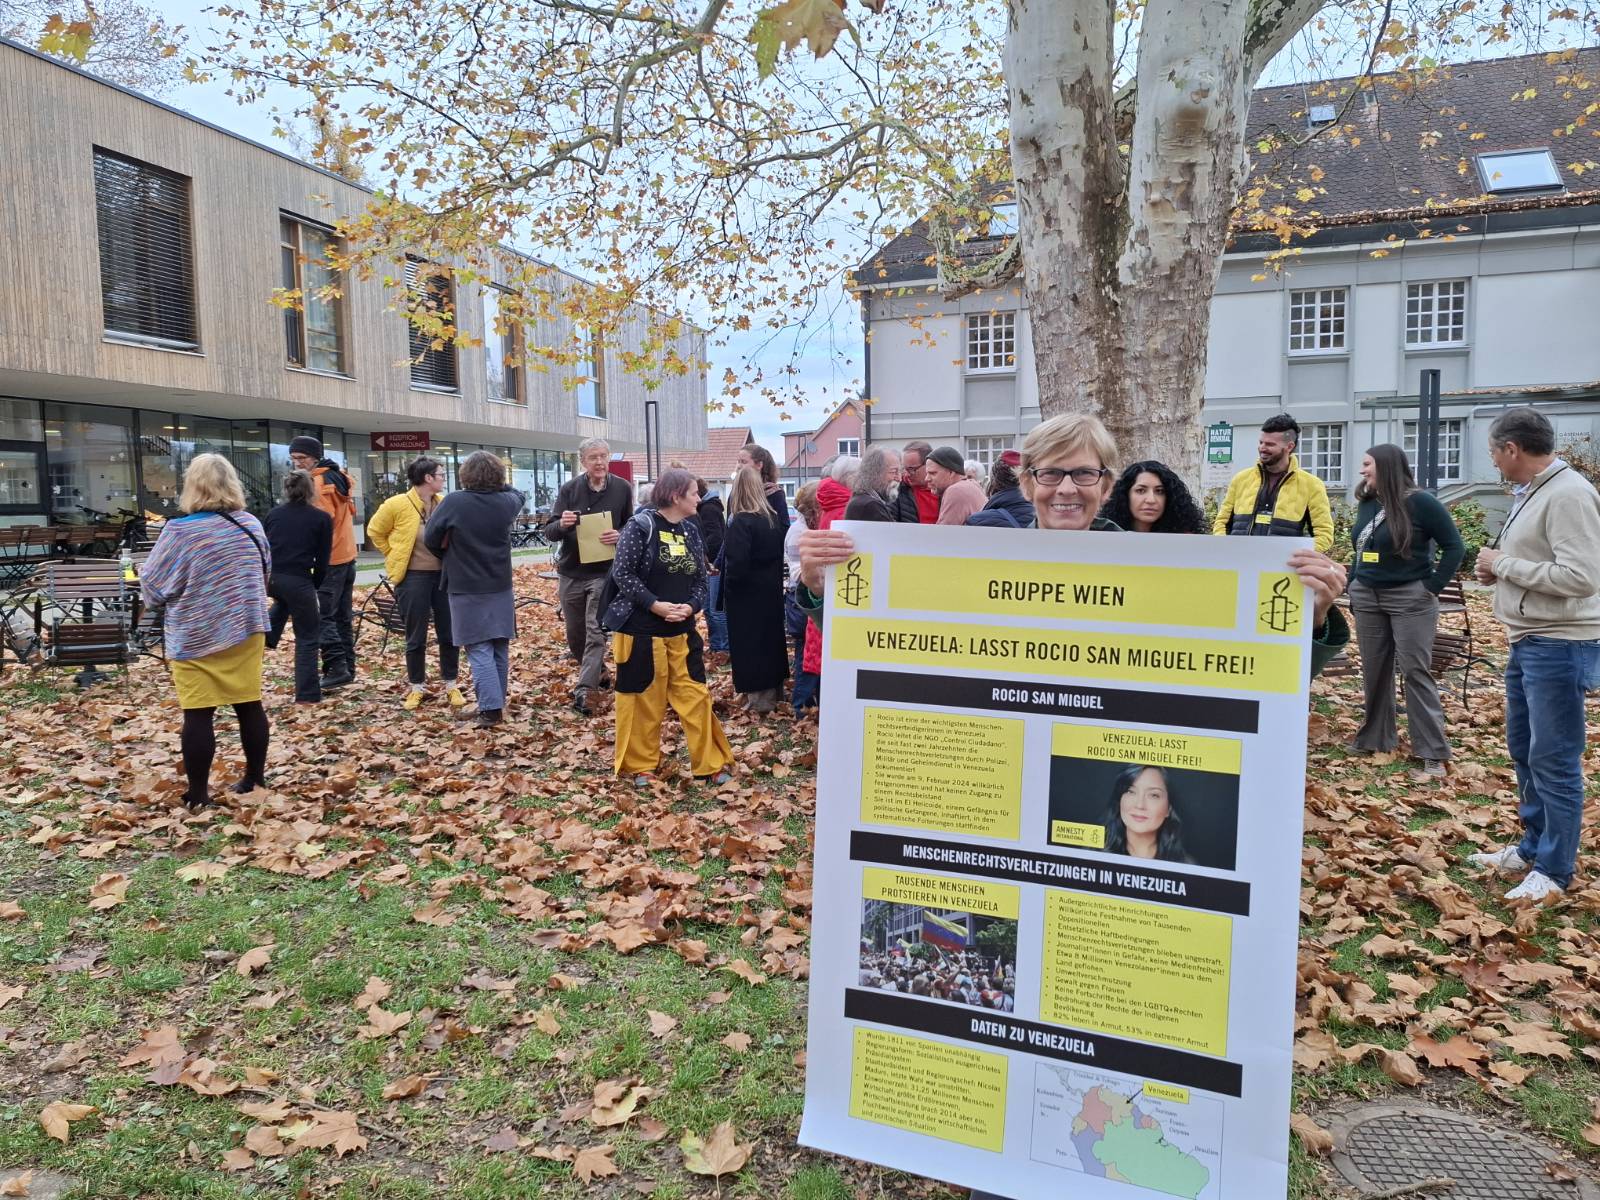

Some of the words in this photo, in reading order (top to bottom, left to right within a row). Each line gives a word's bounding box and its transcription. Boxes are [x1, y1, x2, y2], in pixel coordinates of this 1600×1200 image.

[988, 580, 1065, 603] GRUPPE
[1074, 584, 1124, 606] WIEN
[866, 631, 963, 654] VENEZUELA:
[970, 638, 1020, 658] LASST
[1026, 642, 1080, 662] ROCIO
[1087, 646, 1120, 664] SAN
[1128, 649, 1196, 671] MIGUEL
[1204, 654, 1254, 675] FREI!
[992, 688, 1028, 703] ROCIO
[1032, 690, 1054, 704] SAN
[1058, 692, 1104, 710] MIGUEL
[932, 719, 967, 727] wichtigsten
[969, 722, 1003, 730] Menschen-
[953, 729, 985, 737] Venezuela
[928, 743, 966, 752] Jahrzehnten
[1102, 732, 1156, 747] VENEZUELA:
[1160, 740, 1188, 750] LASST
[876, 747, 963, 761] Menschenrechtsverletzungen
[1088, 746, 1115, 757] ROCIO
[1118, 748, 1136, 760] SAN
[1138, 750, 1174, 764] MIGUEL
[1176, 754, 1202, 767] FREI!
[910, 758, 952, 768] Geheimdienst
[962, 764, 994, 772] Venezuela
[874, 780, 919, 790] festgenommen
[946, 787, 967, 795] keinen
[968, 790, 991, 798] Zugang
[972, 781, 1004, 790] willkürlich
[894, 790, 941, 800] Rechtsbeistand
[873, 804, 902, 813] politische
[873, 812, 915, 822] systematische
[966, 806, 997, 815] Gefängnis
[1056, 825, 1085, 835] AMNESTY
[902, 844, 1096, 882] MENSCHENRECHTSVERLETZUNGEN
[1100, 870, 1113, 884] IN
[1116, 872, 1186, 896] VENEZUELA
[896, 875, 936, 890] TAUSENDE
[940, 881, 985, 896] MENSCHEN
[882, 887, 936, 902] PROTSTIEREN
[940, 894, 948, 904] IN
[951, 896, 998, 912] VENEZUELA
[1059, 896, 1116, 911] Außergerichtliche
[1119, 906, 1168, 919] Hinrichtungen
[1058, 905, 1097, 917] Willkürliche
[1099, 912, 1136, 923] Festnahme
[1153, 920, 1190, 932] Tausenden
[1058, 914, 1109, 928] Oppositionellen
[1057, 923, 1098, 935] Entsetzliche
[1100, 930, 1159, 945] Haftbedingungen
[1057, 931, 1154, 954] Menschenrechtsverletzungen
[1156, 948, 1182, 958] blieben
[1056, 958, 1072, 966] Land
[1056, 949, 1072, 957] Etwa
[1081, 954, 1112, 965] Millionen
[1196, 974, 1211, 982] dem
[1122, 952, 1147, 962] Gefahr,
[1149, 956, 1168, 965] keine
[1170, 960, 1224, 975] Medienfreiheit!
[1055, 967, 1131, 987] Umweltverschmutzung
[1055, 976, 1077, 986] Gewalt
[1079, 982, 1099, 990] gegen
[1101, 984, 1124, 994] Frauen
[1054, 985, 1073, 994] Keine
[1076, 989, 1114, 1001] Fortschritte
[1116, 996, 1126, 1004] bei
[1129, 999, 1141, 1007] den
[1054, 994, 1089, 1007] Bedrohung
[1105, 1003, 1128, 1013] Rechte
[1131, 1008, 1142, 1016] der
[1054, 1003, 1094, 1017] Bevölkerung
[970, 1018, 1006, 1038] DATEN
[1009, 1026, 1024, 1042] ZU
[1028, 1030, 1095, 1056] VENEZUELA
[1053, 1011, 1069, 1020] 82%
[1071, 1015, 1089, 1024] leben
[1100, 1021, 1123, 1031] Armut,
[1126, 1026, 1143, 1035] 53%
[1154, 1031, 1184, 1043] extremer
[1186, 1038, 1208, 1048] Armut
[912, 1067, 924, 1075] und
[955, 1059, 1000, 1073] ausgerichtetes
[908, 1075, 922, 1083] Wahl
[910, 1084, 929, 1093] 31,25
[962, 1096, 994, 1108] Menschen
[1148, 1085, 1184, 1098] Venezuela
[939, 1109, 956, 1118] 2014
[958, 1113, 972, 1121] aber
